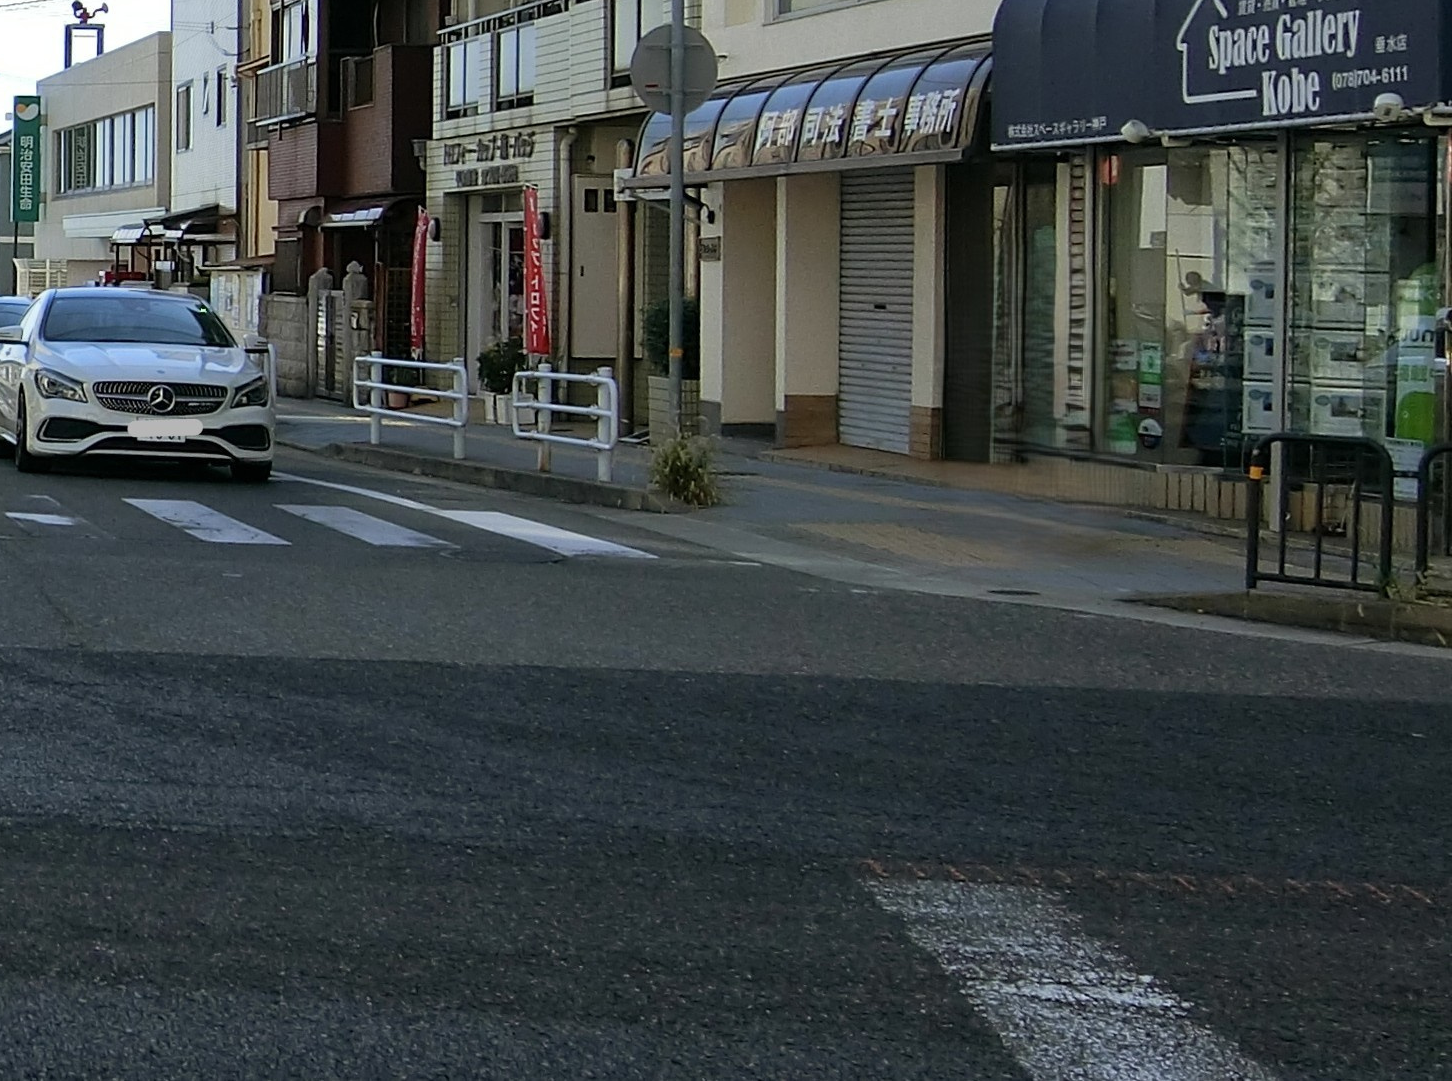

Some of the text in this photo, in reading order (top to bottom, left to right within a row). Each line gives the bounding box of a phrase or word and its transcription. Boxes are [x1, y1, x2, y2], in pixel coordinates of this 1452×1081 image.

[1208, 9, 1360, 75] Space Gallery
[1374, 34, 1408, 54] 垂水店
[1262, 67, 1320, 116] Kobe
[1331, 65, 1408, 91] (078)704-6111
[19, 134, 34, 211] 明治安田生命
